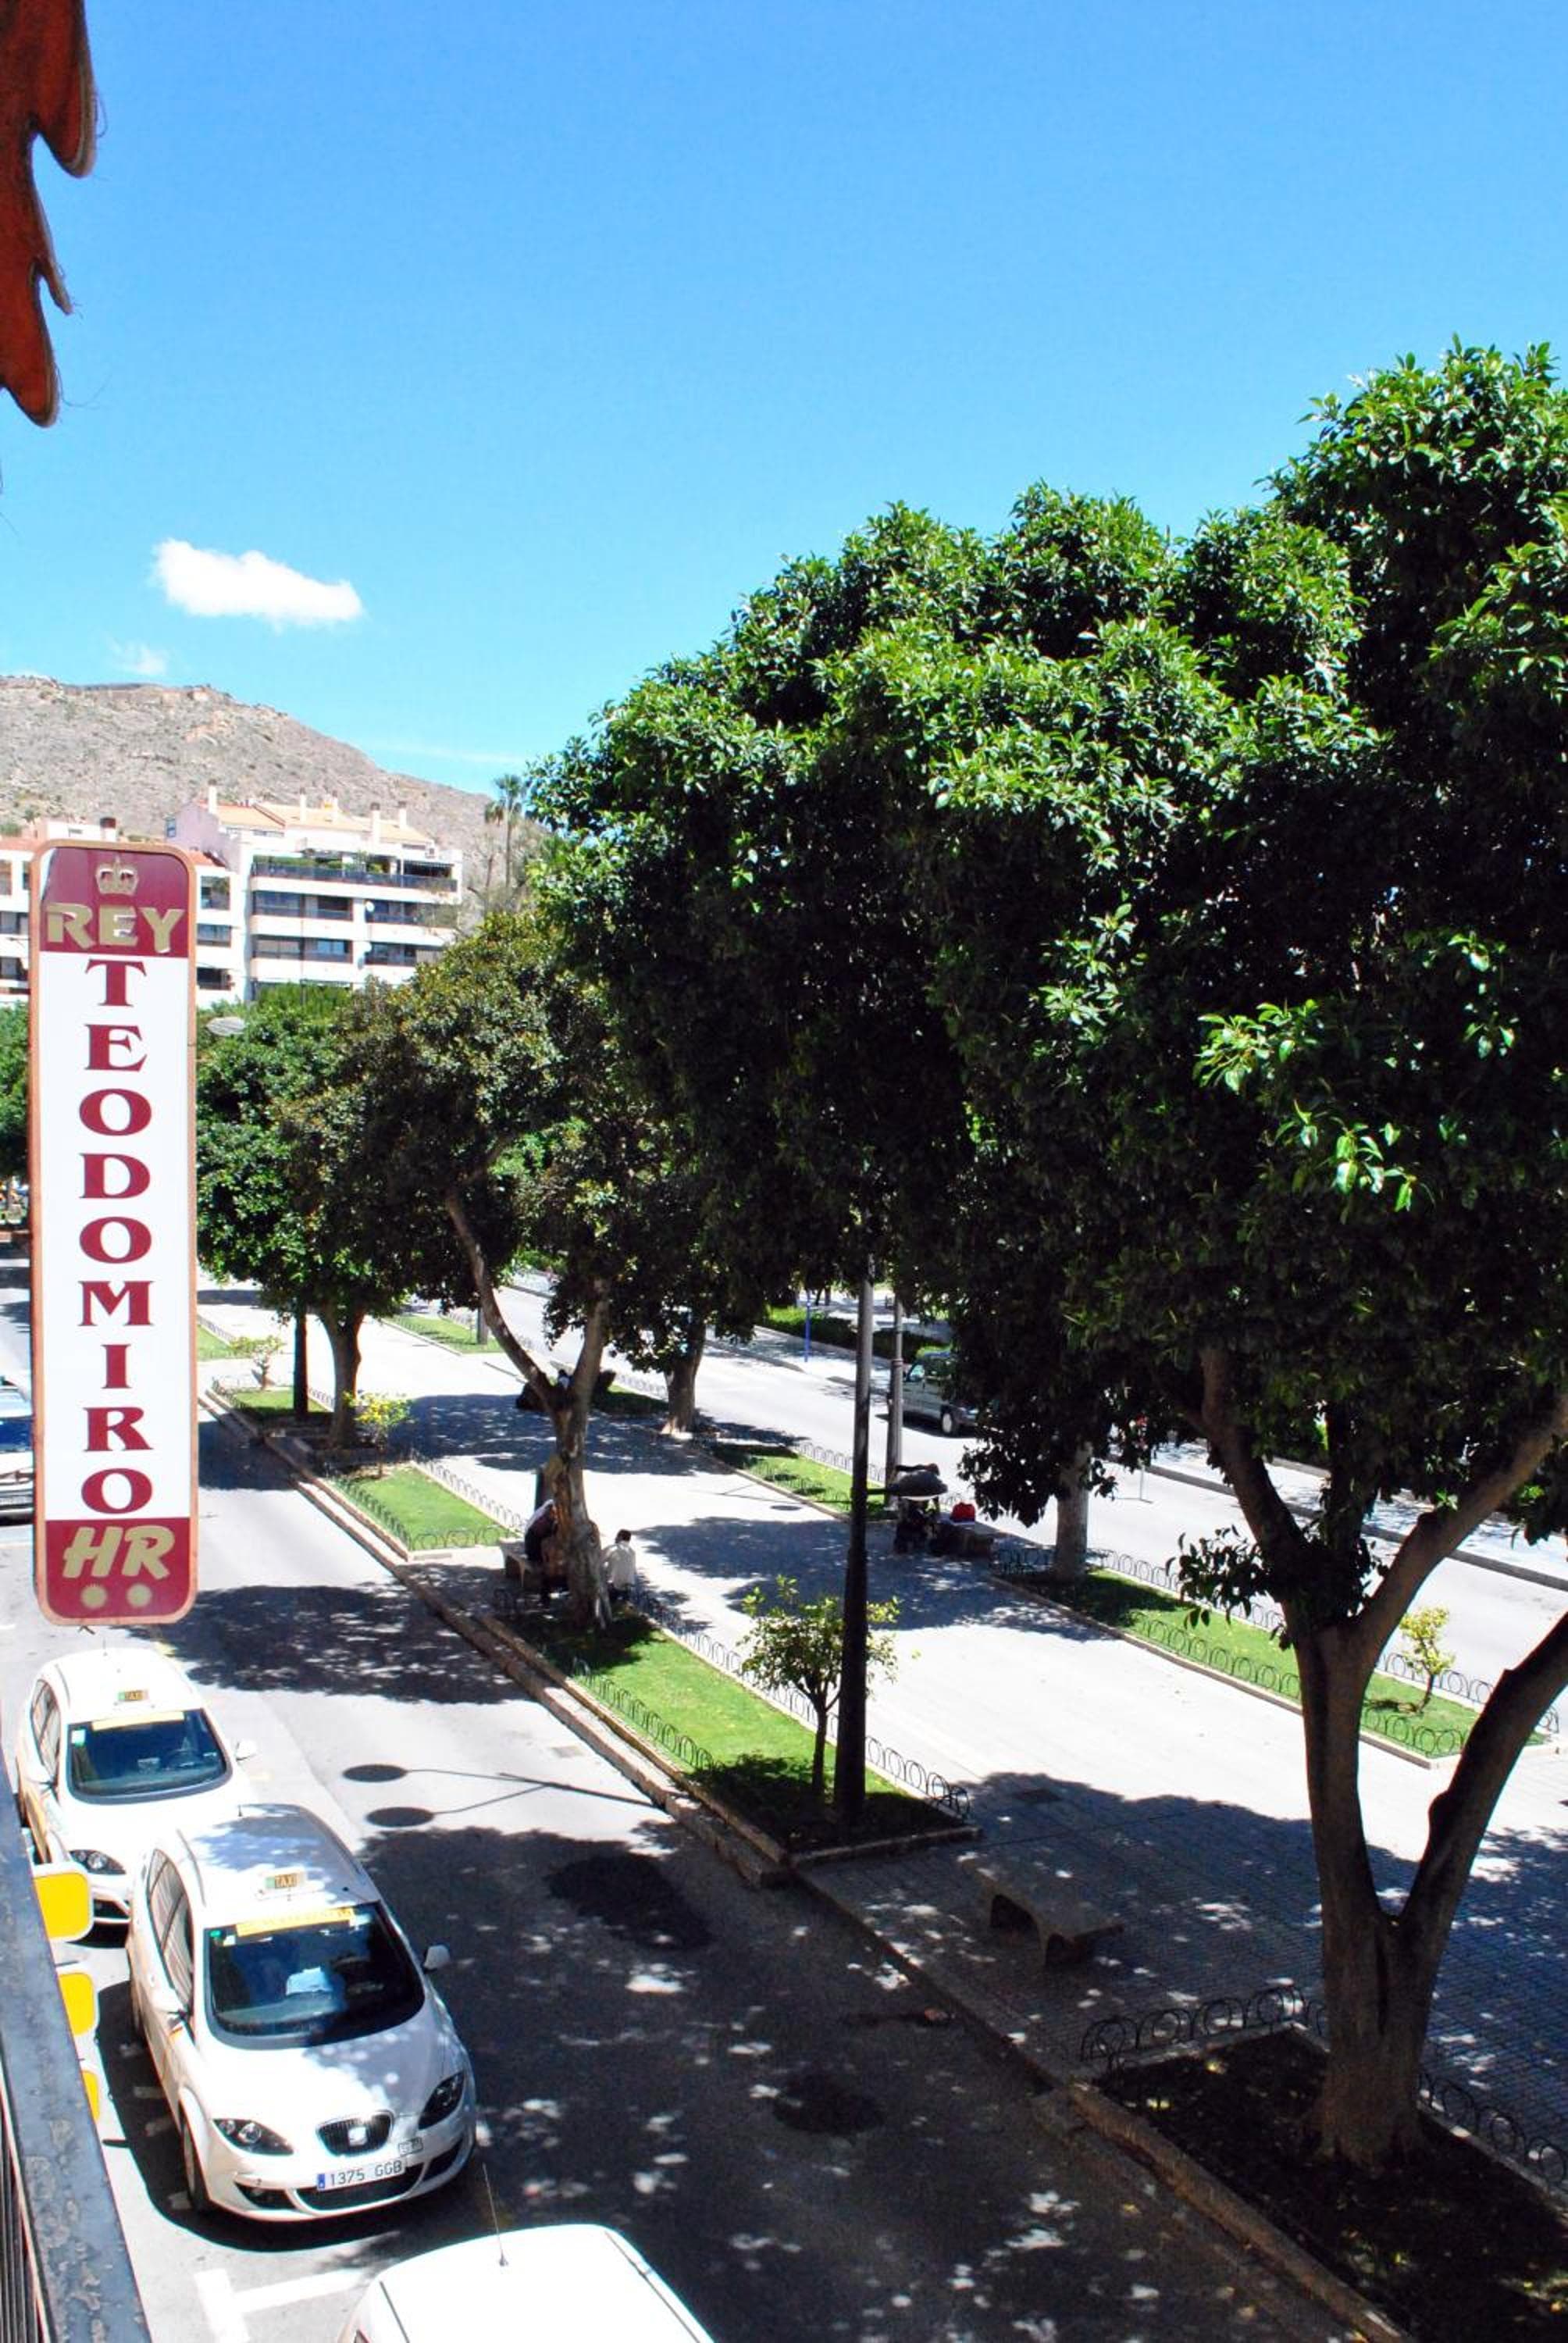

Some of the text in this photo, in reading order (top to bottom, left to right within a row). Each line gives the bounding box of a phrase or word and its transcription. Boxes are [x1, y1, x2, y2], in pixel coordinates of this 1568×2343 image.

[46, 901, 184, 954] REY
[78, 958, 155, 1514] TEODOMIRO
[62, 1525, 176, 1580] HR
[330, 2160, 402, 2185] 1375 GGB
